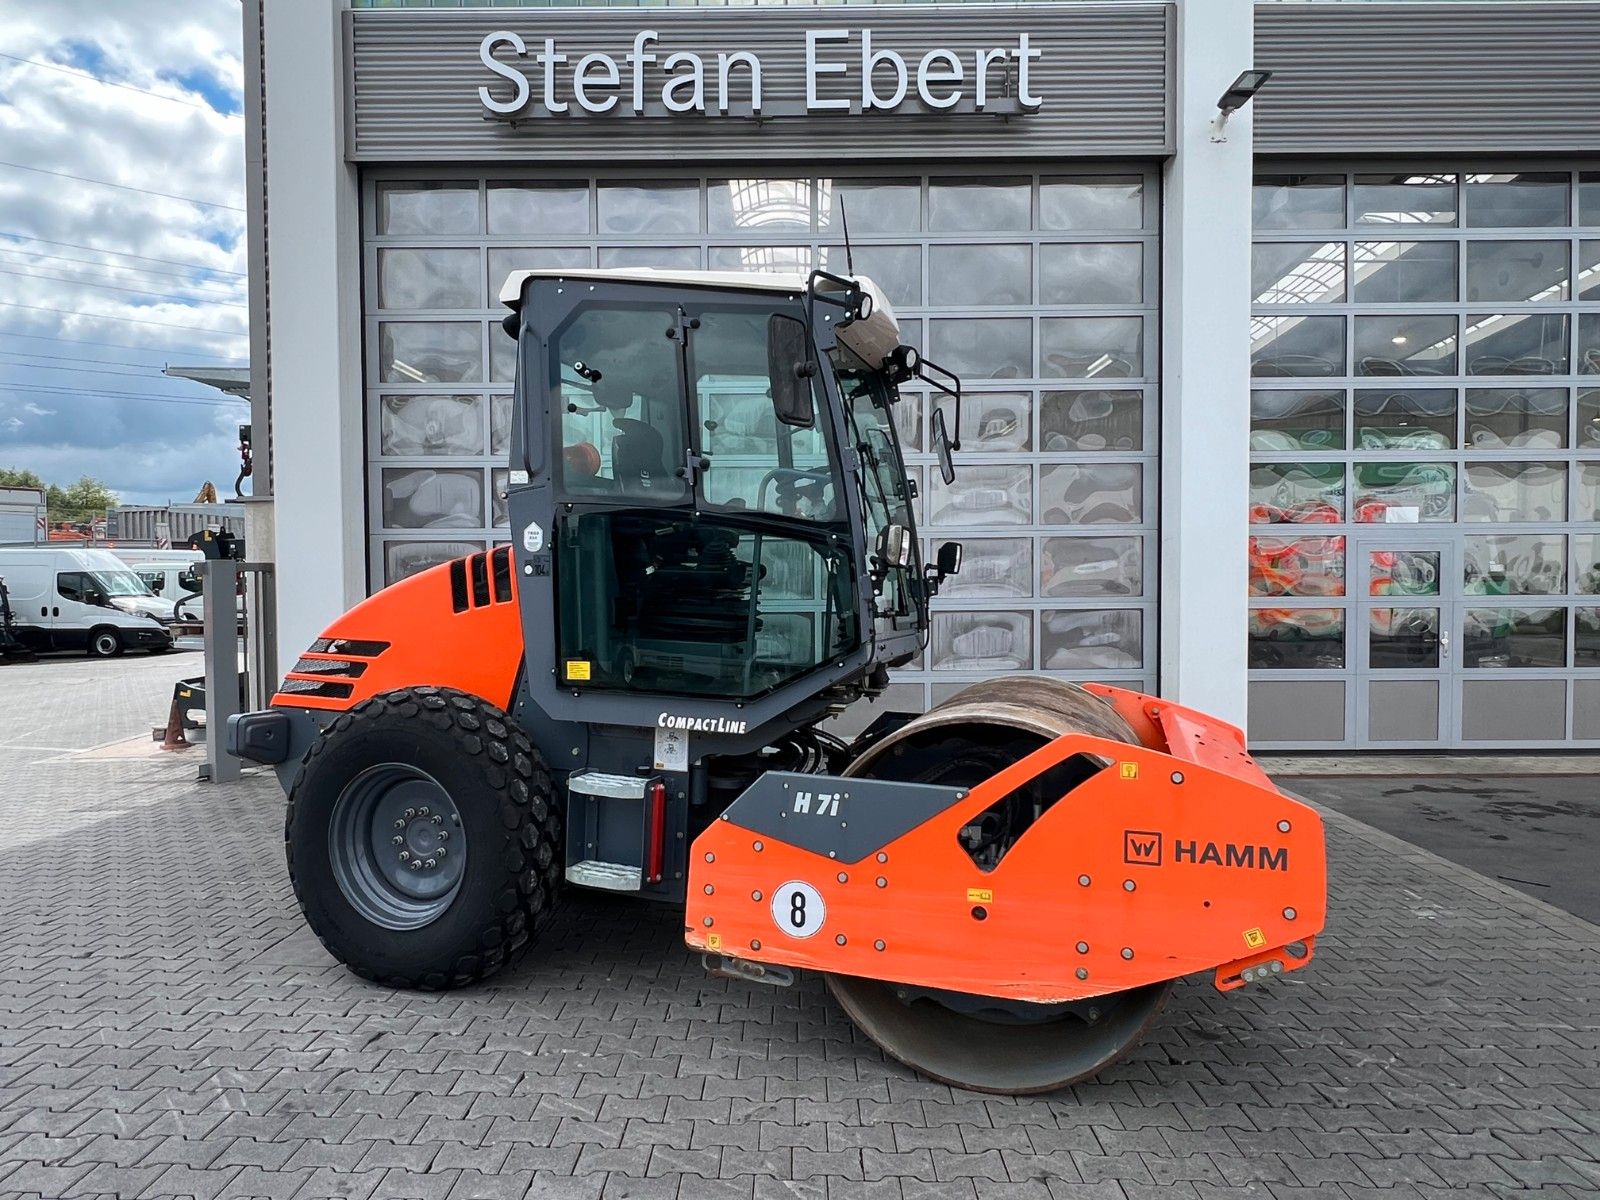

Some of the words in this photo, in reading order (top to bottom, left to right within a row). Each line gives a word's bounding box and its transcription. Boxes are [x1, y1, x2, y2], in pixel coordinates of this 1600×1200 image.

[478, 29, 762, 113] Stefan
[805, 28, 1043, 109] Ebert
[658, 712, 747, 734] COMPACTLINE
[793, 791, 812, 814] H
[816, 793, 840, 817] 7i
[1175, 839, 1288, 872] HAMM
[791, 891, 806, 928] 8
